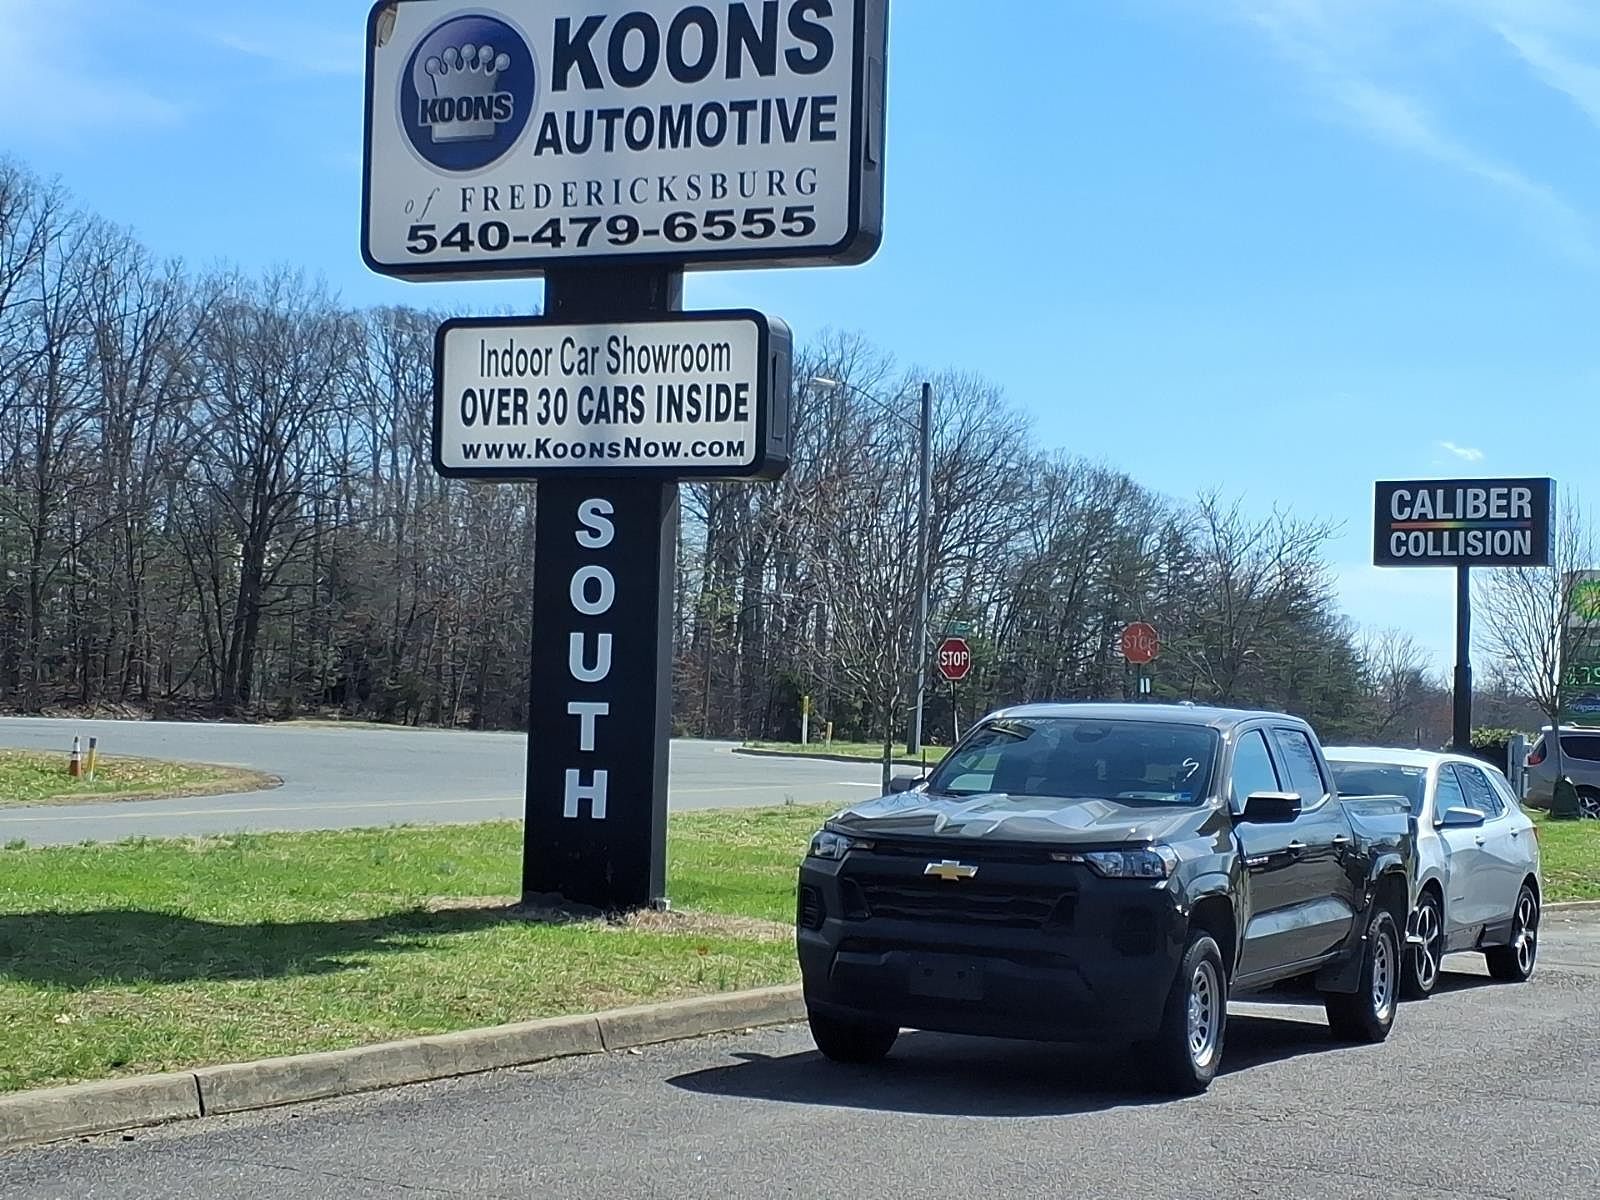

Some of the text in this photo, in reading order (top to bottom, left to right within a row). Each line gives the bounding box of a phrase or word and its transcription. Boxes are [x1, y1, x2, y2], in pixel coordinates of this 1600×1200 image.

[551, 0, 835, 92] KOONS
[420, 94, 513, 125] KOONS
[534, 96, 837, 156] AUTOMOTIVE
[404, 167, 819, 223] of FREDERICKSBURG
[405, 205, 817, 255] 540-479-6555
[480, 335, 731, 377] Indoor Car Showroom
[460, 383, 749, 427] OVER 30 CARS INSIDE
[1390, 487, 1532, 521] CALIBER
[1390, 530, 1531, 558] COLLISION
[563, 498, 616, 819] SOUTH
[941, 651, 968, 666] STOP
